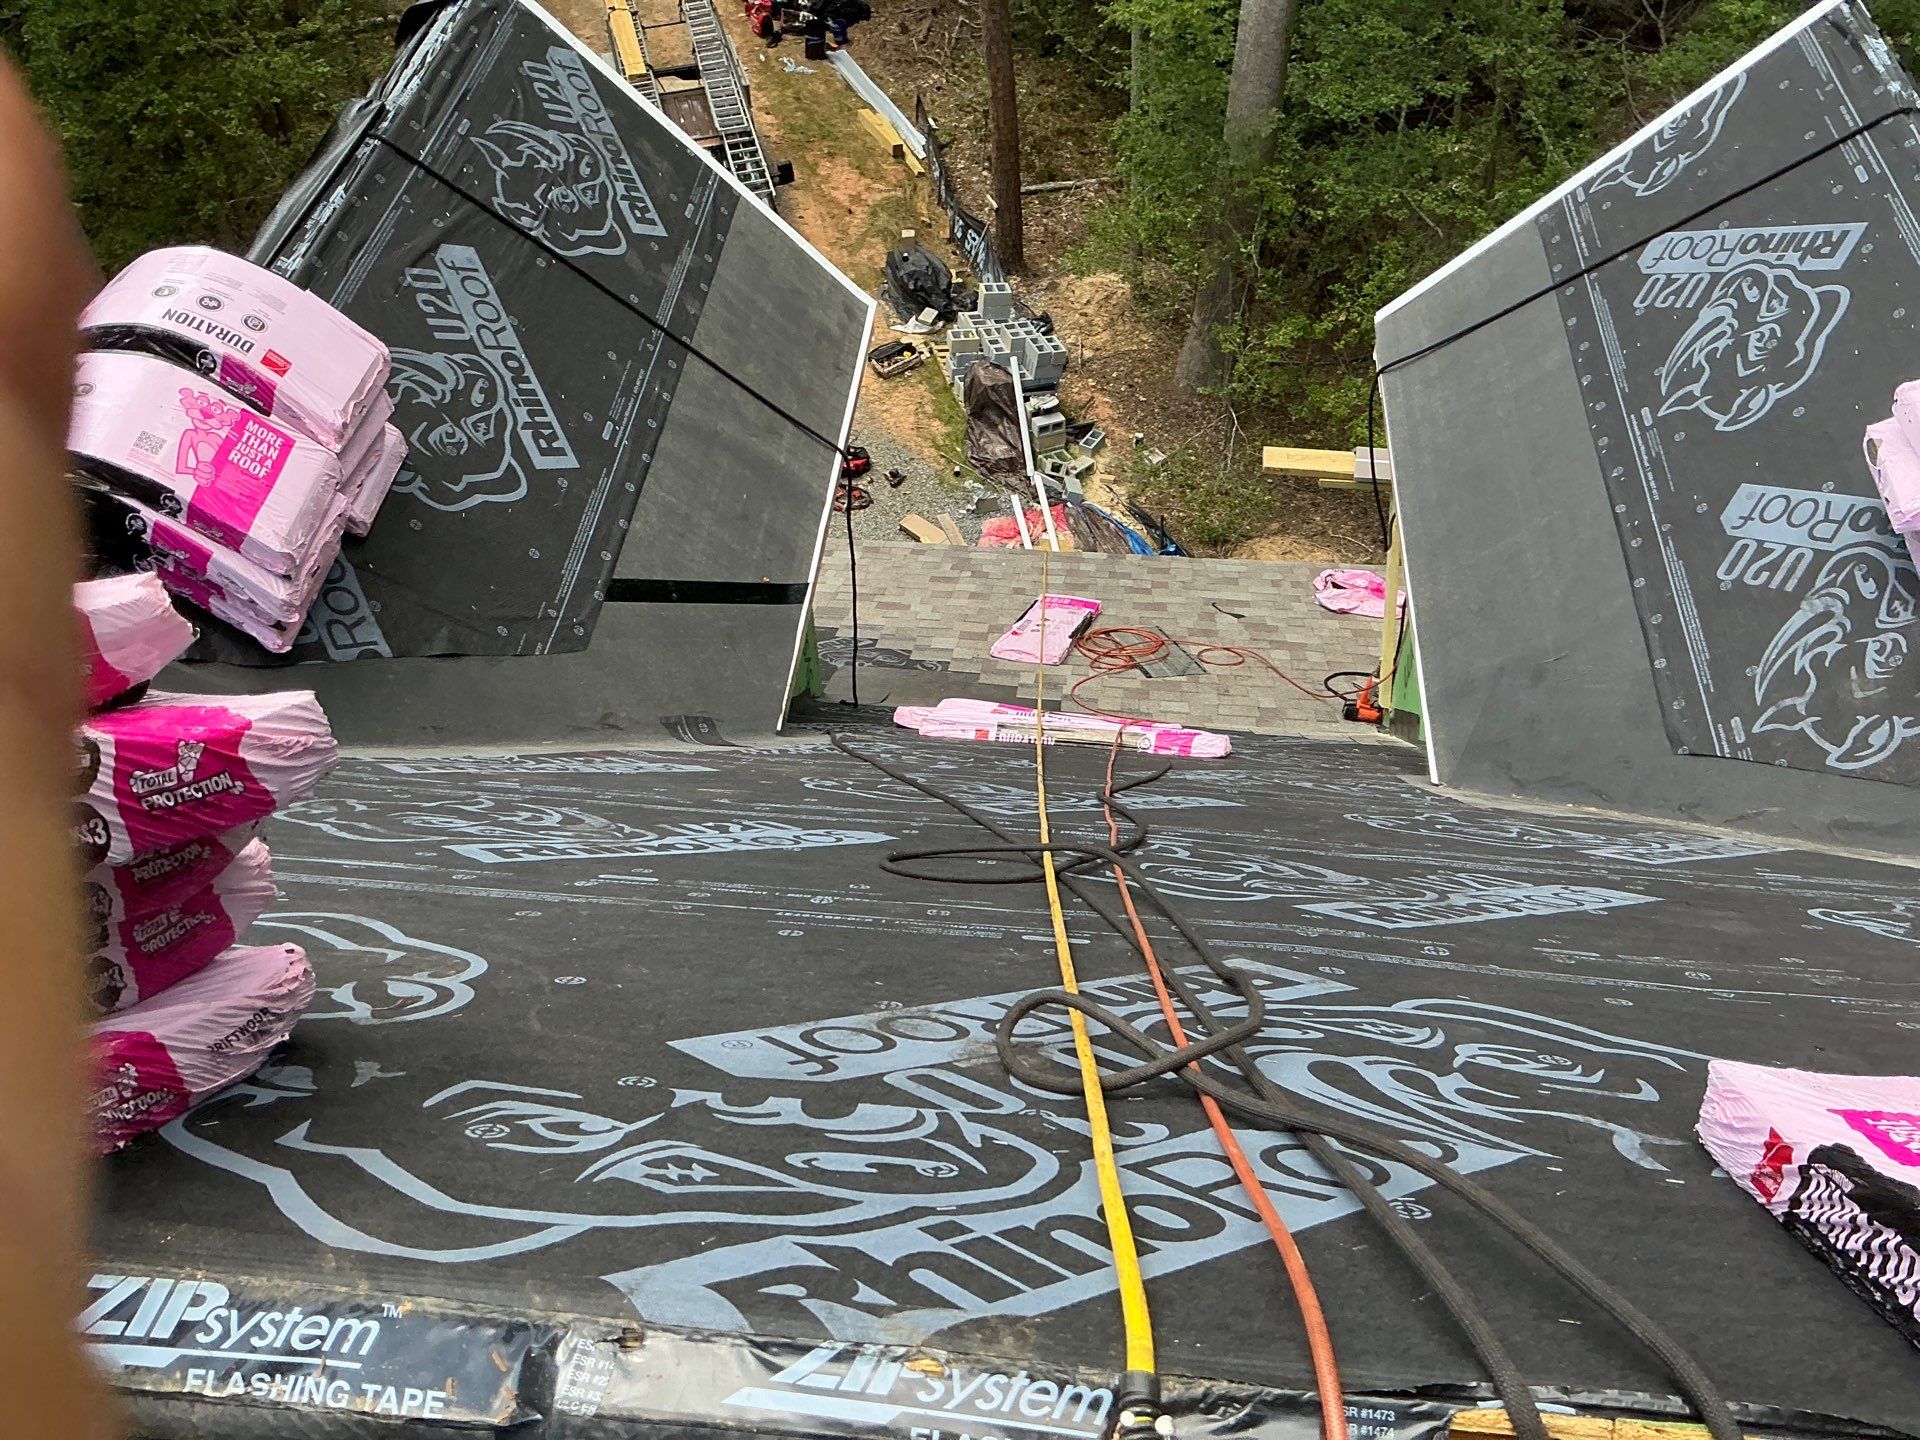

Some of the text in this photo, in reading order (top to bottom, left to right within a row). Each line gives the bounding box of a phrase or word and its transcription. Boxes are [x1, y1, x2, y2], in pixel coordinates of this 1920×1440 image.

[522, 60, 577, 123] U20
[404, 266, 471, 340] U20
[1633, 273, 1711, 308] U20
[162, 308, 255, 353] DURATION
[440, 257, 569, 457] RhinoRoof
[240, 430, 280, 460] THAN
[245, 420, 284, 449] MORE
[228, 450, 270, 478] ROOF
[235, 442, 273, 470] JUST A
[1716, 538, 1815, 592] U20
[139, 771, 175, 789] TOTAL
[141, 772, 235, 810] PROTECTION
[572, 1353, 596, 1368] ESR
[185, 1369, 446, 1419] FLASHING TAPE
[1360, 1408, 1396, 1421] #1473
[1360, 1425, 1395, 1438] #1474
